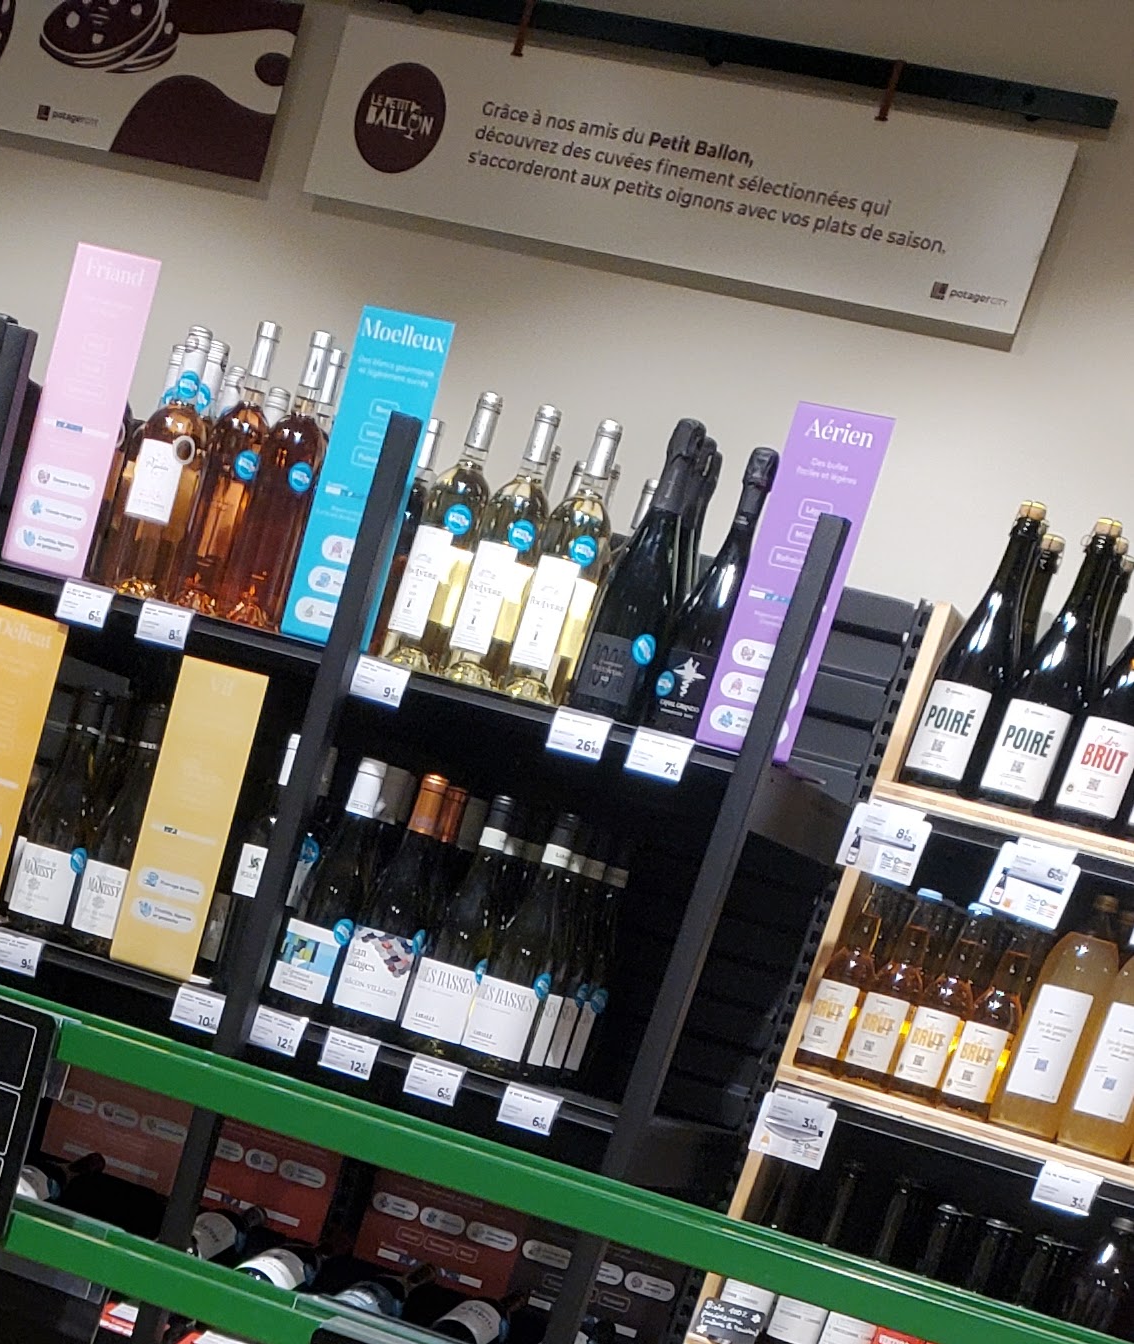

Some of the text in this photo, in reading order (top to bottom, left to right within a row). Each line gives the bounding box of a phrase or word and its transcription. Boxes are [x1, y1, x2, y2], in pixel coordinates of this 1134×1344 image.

[366, 104, 434, 140] BALLON
[482, 101, 754, 168] Grâce à nos amis du Petit Ballon,
[476, 126, 892, 217] découvrez des cuvées finement sélectionnées qui
[468, 150, 946, 254] s'accorderont aux petits oignons avec vos plats de saison.
[86, 256, 145, 287] Friand
[361, 317, 446, 353] Moelleux
[804, 418, 873, 448] Aérien
[925, 705, 976, 737] POIRÉ
[1002, 724, 1056, 758] POIRÉ
[1081, 743, 1128, 775] BRUT
[23, 857, 57, 880] MANISSY
[88, 875, 121, 898] MANISSY
[814, 999, 845, 1021] BRUT
[862, 1013, 896, 1036] BRUT
[912, 1027, 946, 1051] BRUT
[961, 1042, 994, 1066] BRUT
